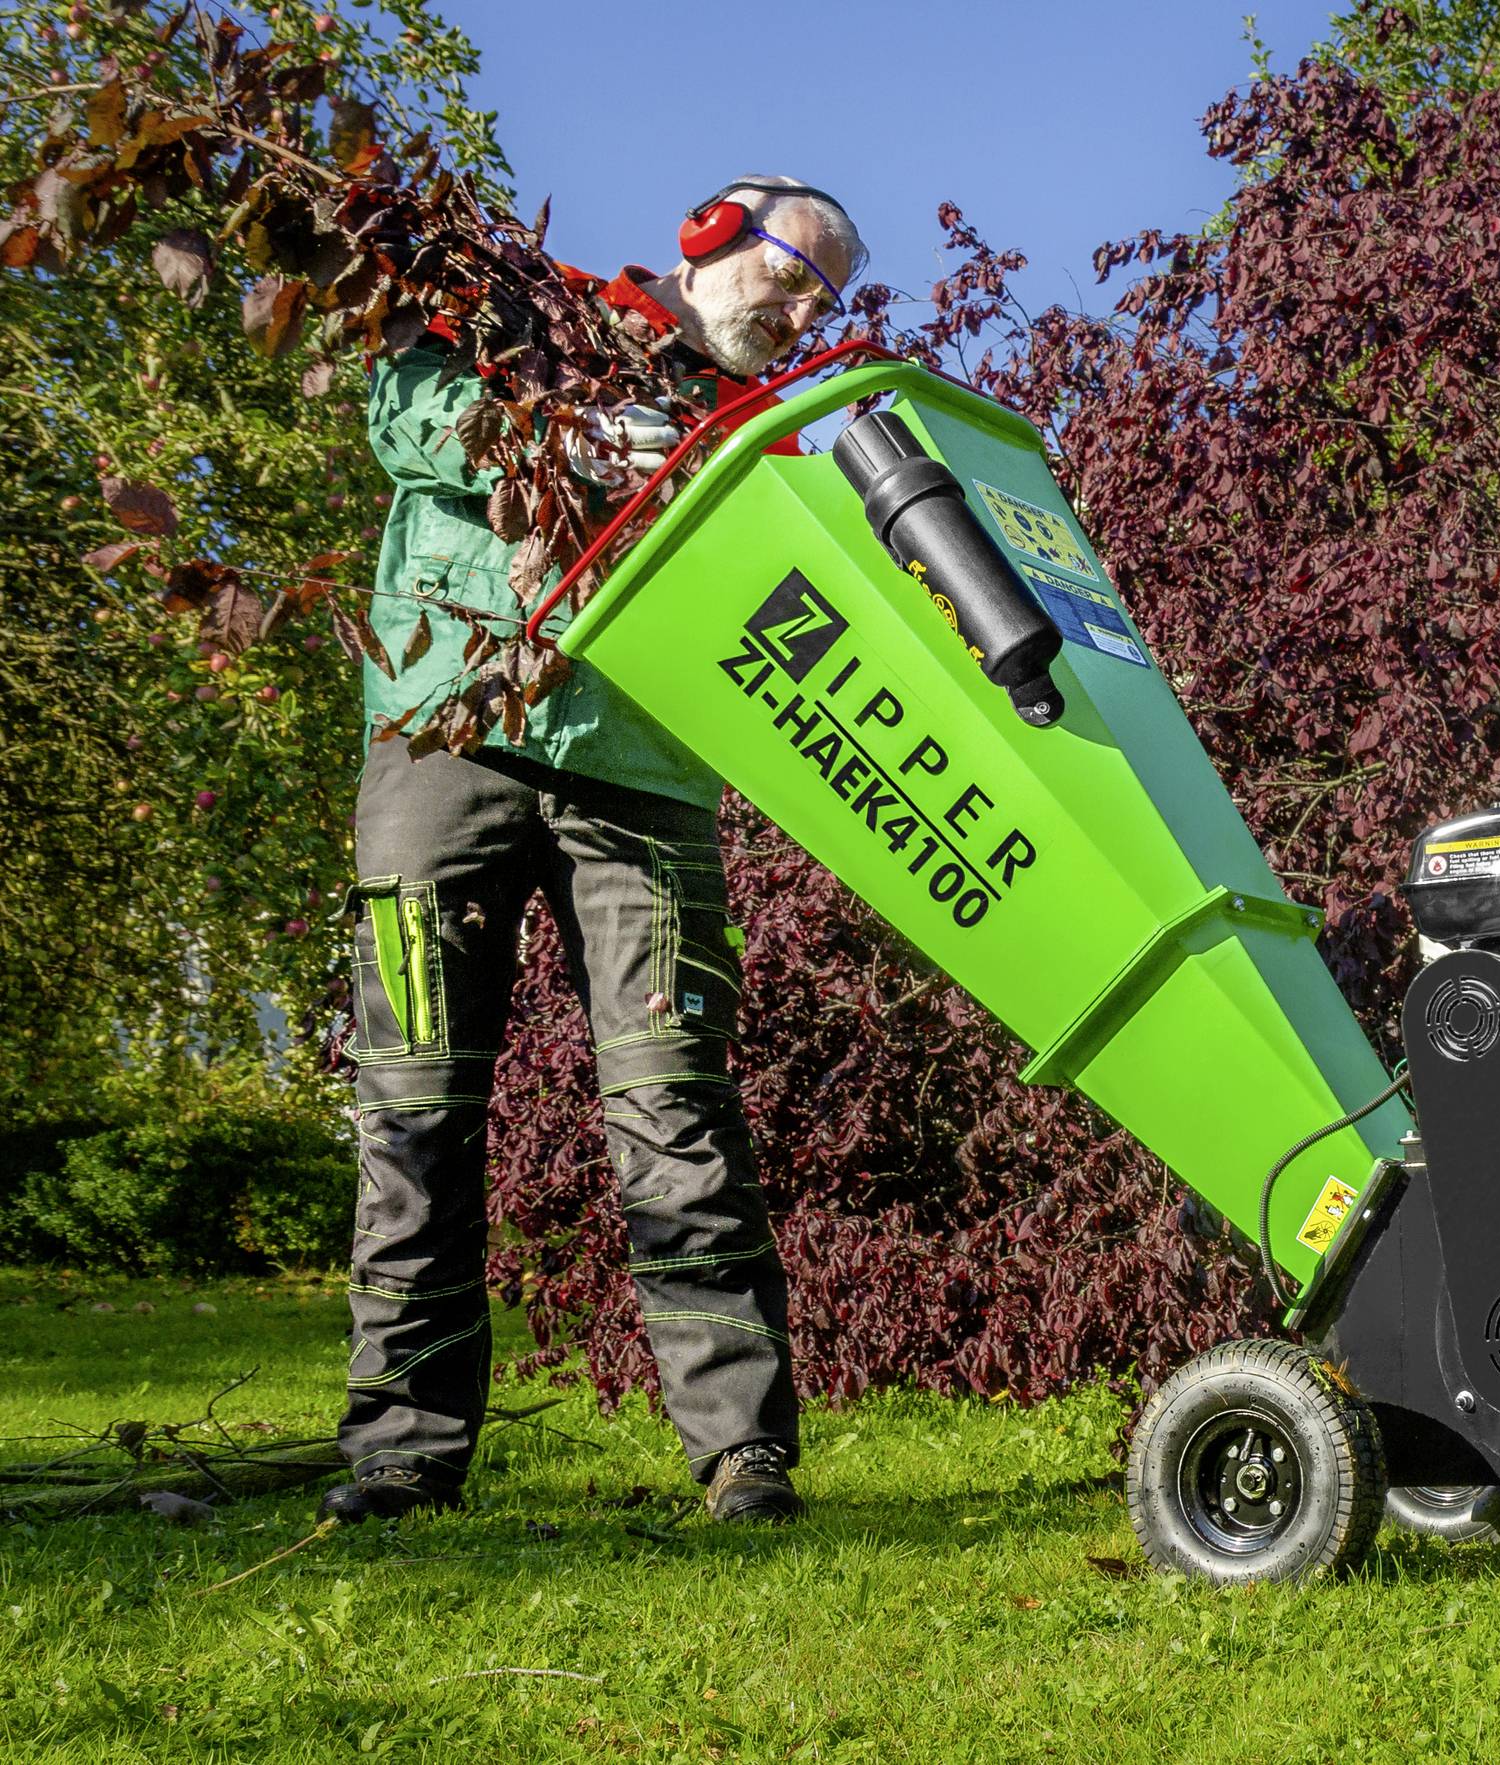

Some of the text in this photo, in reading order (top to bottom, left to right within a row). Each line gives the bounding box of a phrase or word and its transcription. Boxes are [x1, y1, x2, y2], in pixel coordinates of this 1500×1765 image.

[998, 492, 1048, 520] DANGER
[1044, 574, 1094, 600] DANGER
[716, 635, 989, 928] ZI-HAEK4100
